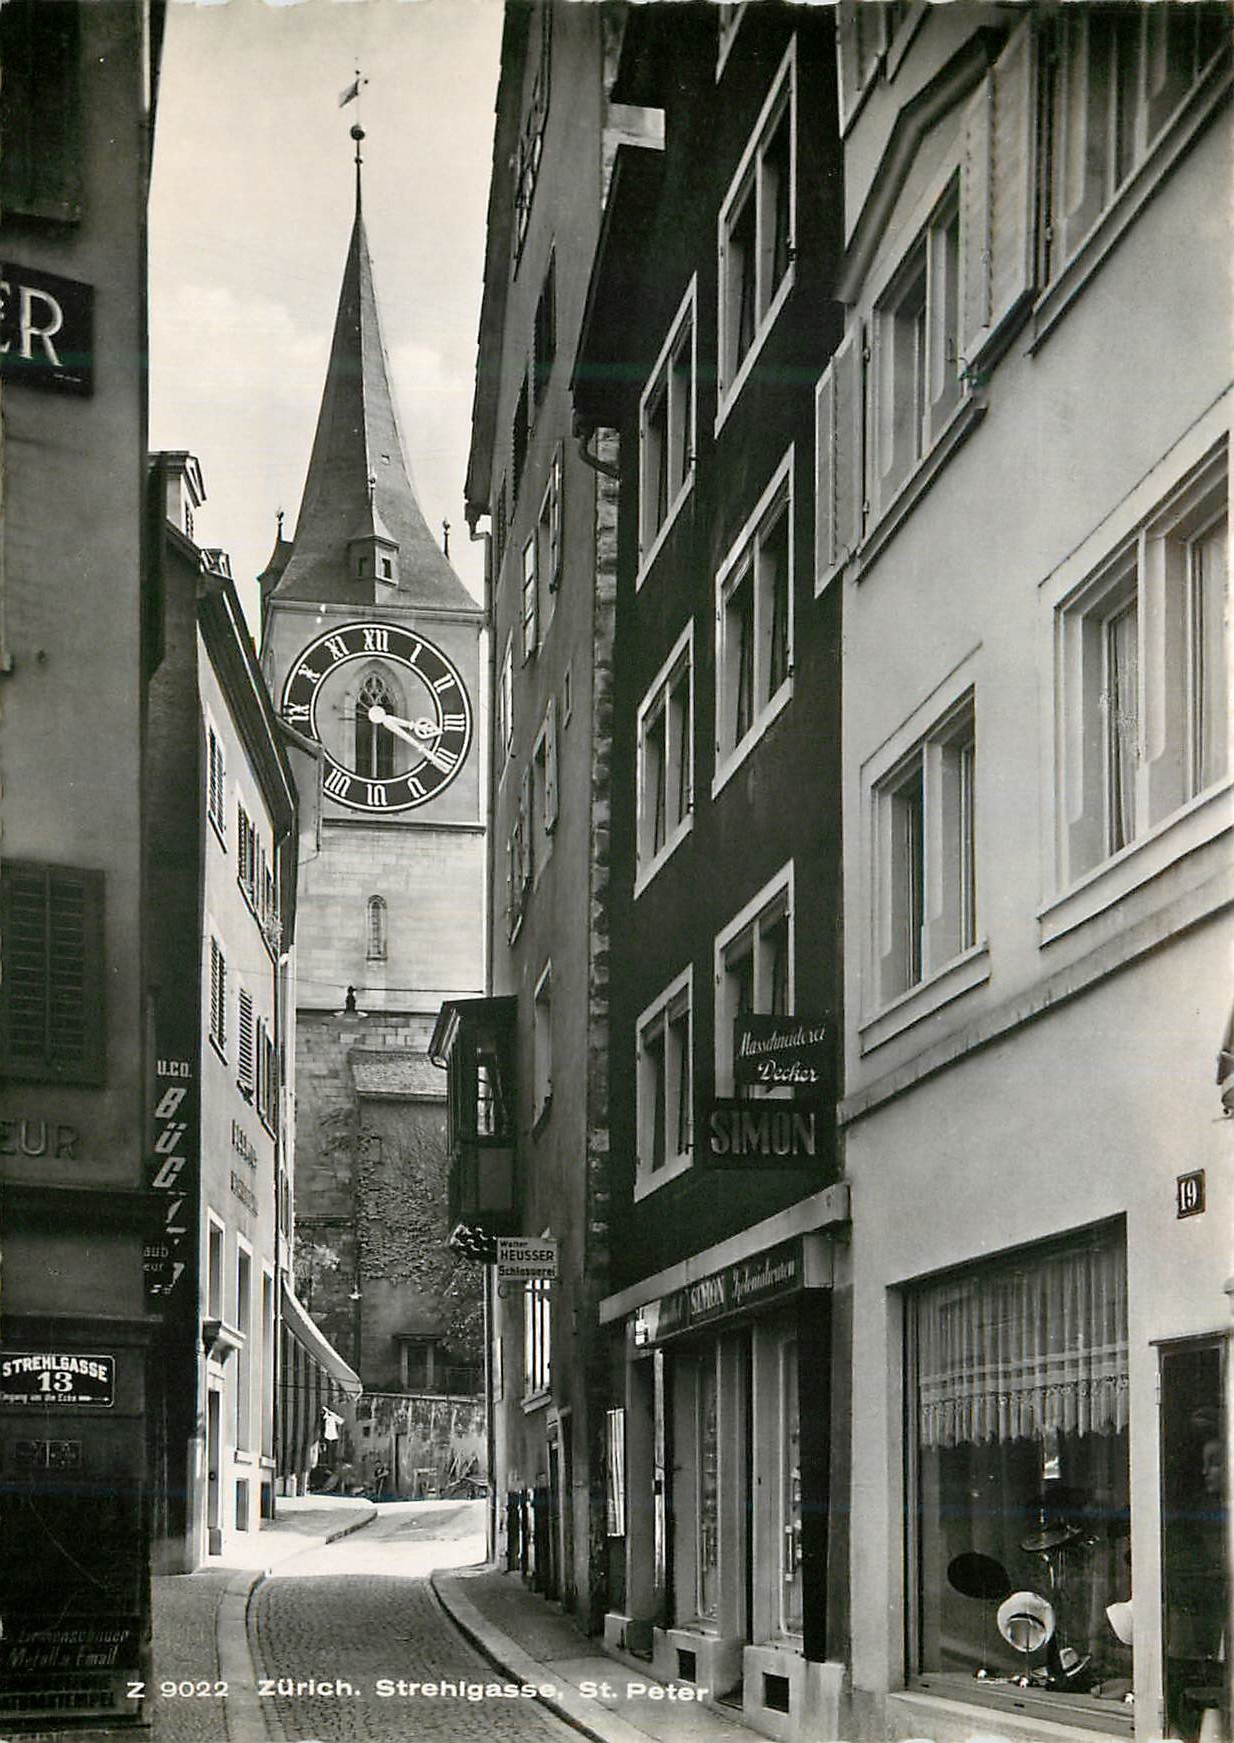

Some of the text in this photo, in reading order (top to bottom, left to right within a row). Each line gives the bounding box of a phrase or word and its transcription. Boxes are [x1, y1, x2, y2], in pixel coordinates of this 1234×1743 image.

[324, 635, 350, 661] XI
[363, 629, 389, 651] XII
[409, 643, 423, 663] I
[299, 663, 321, 683] X
[433, 673, 456, 693] II
[443, 713, 466, 732] III
[757, 1058, 819, 1083] Decker
[710, 1110, 816, 1156] SIMON
[1180, 1181, 1198, 1211] 19
[500, 1241, 529, 1249] Walter
[500, 1249, 555, 1261] HEUSSER
[690, 1275, 725, 1316] SIMON
[2, 1356, 108, 1383] STREHLGASSE
[37, 1371, 73, 1392] 13
